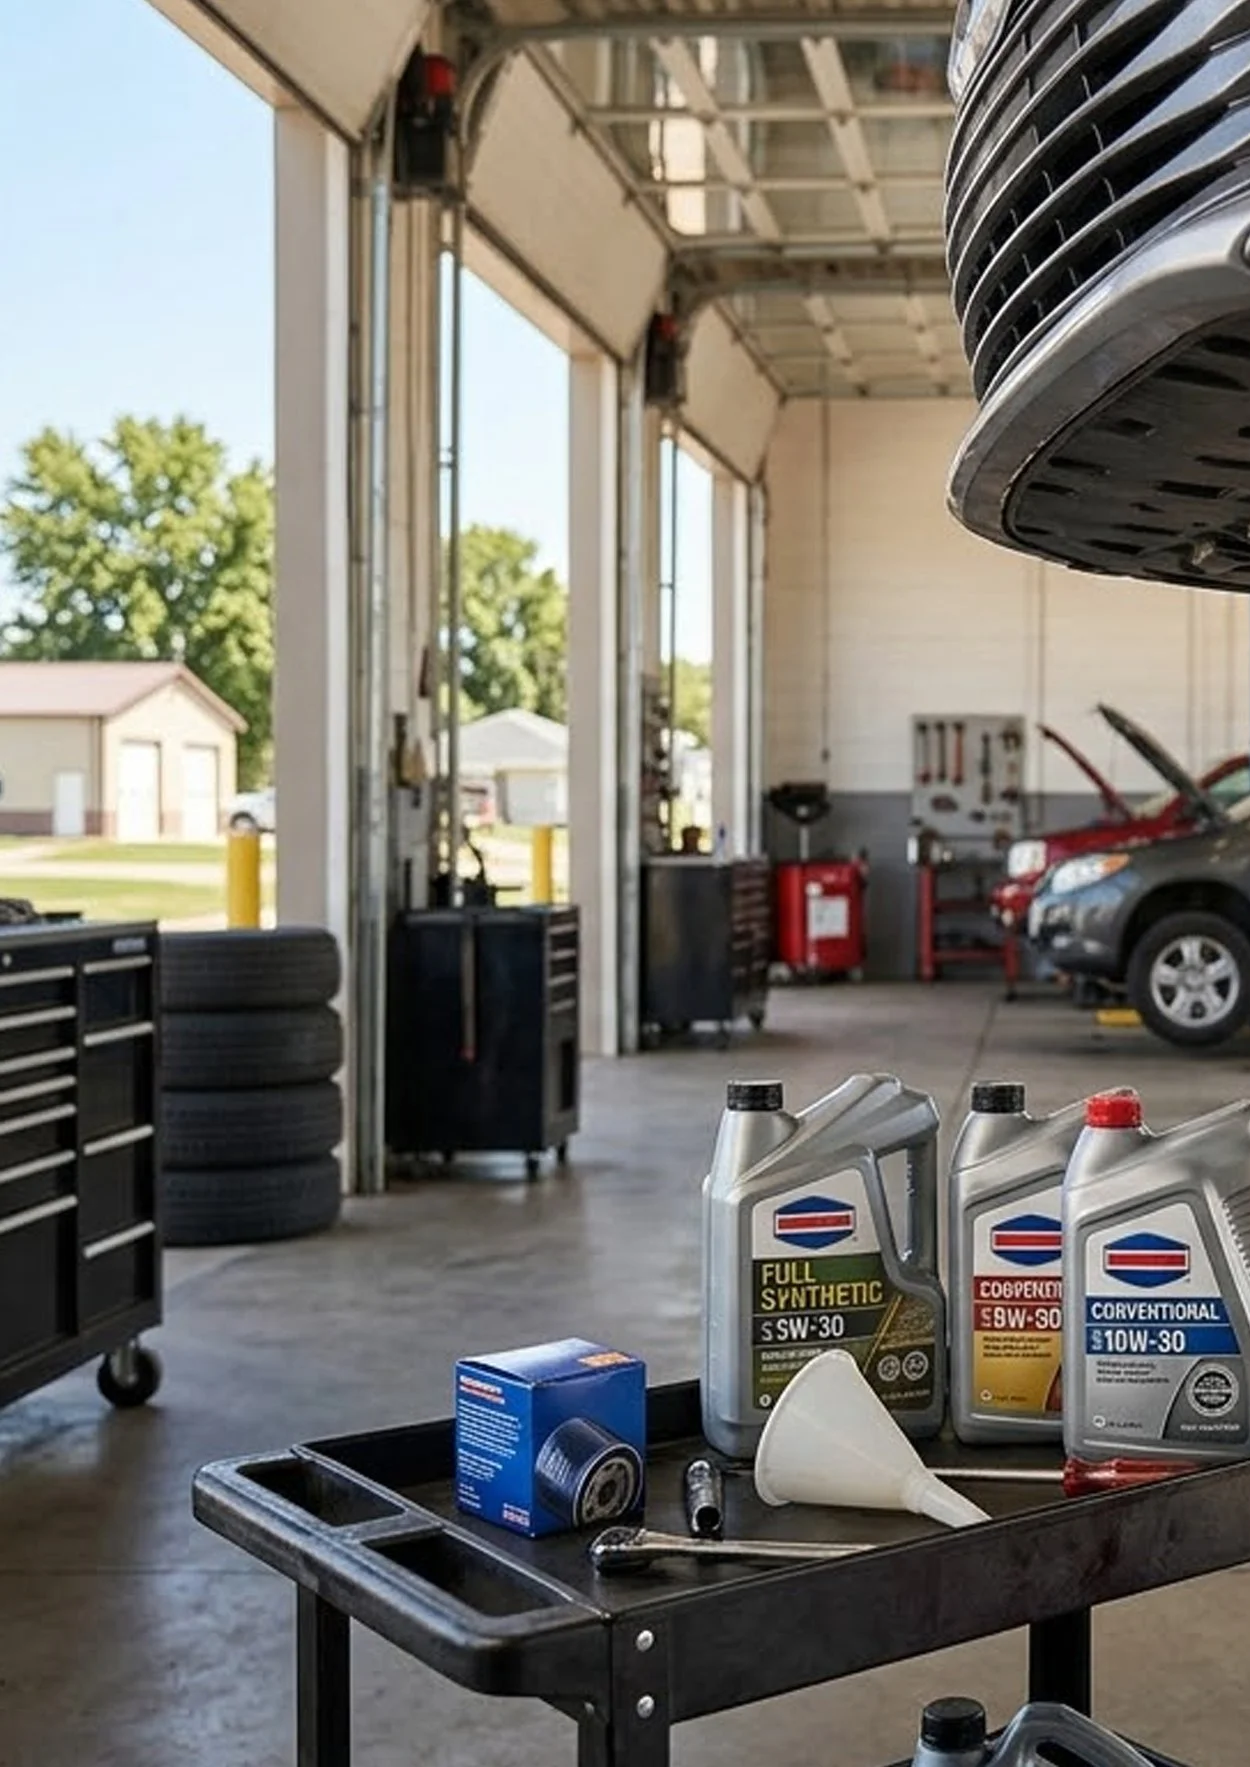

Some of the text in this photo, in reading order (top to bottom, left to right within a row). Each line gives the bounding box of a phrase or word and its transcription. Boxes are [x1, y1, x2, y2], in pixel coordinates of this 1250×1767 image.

[761, 1261, 817, 1286] FULL
[760, 1280, 884, 1312] SYNTHETIC
[1103, 1329, 1186, 1353] 10W-30
